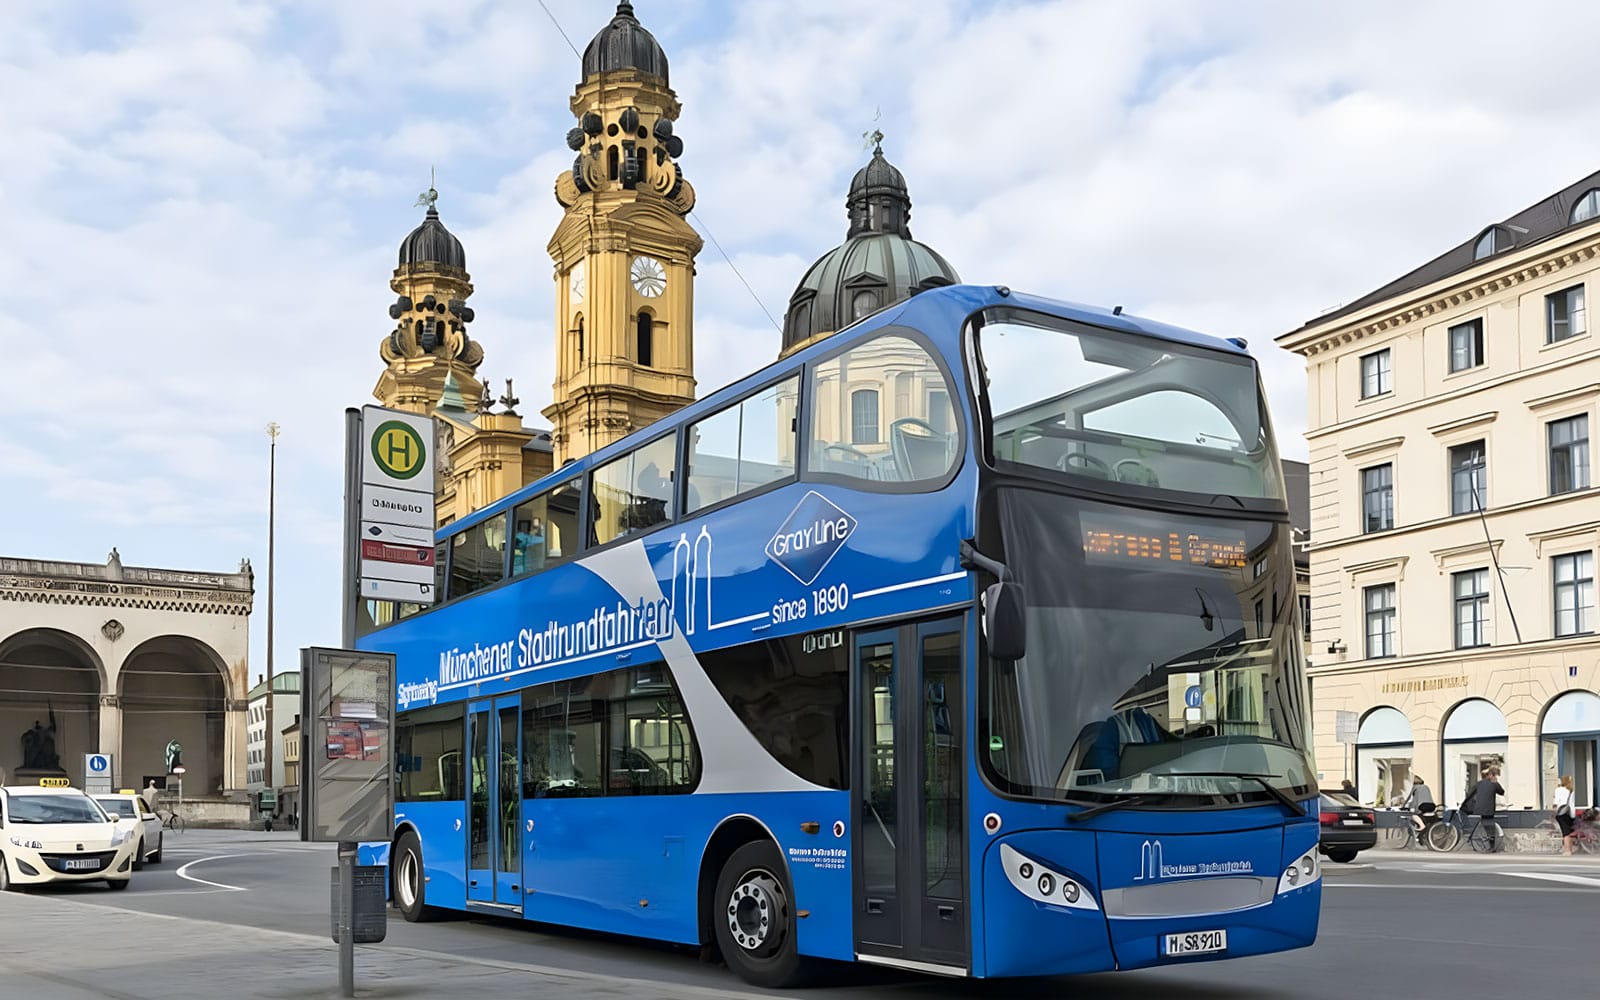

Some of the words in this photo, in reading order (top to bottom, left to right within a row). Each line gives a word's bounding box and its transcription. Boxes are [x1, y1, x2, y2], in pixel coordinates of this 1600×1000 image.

[388, 432, 410, 468] H
[772, 598, 807, 625] since
[812, 582, 849, 617] 1890
[439, 640, 514, 686] Münchener
[518, 596, 673, 668] Stadtrundfahrten
